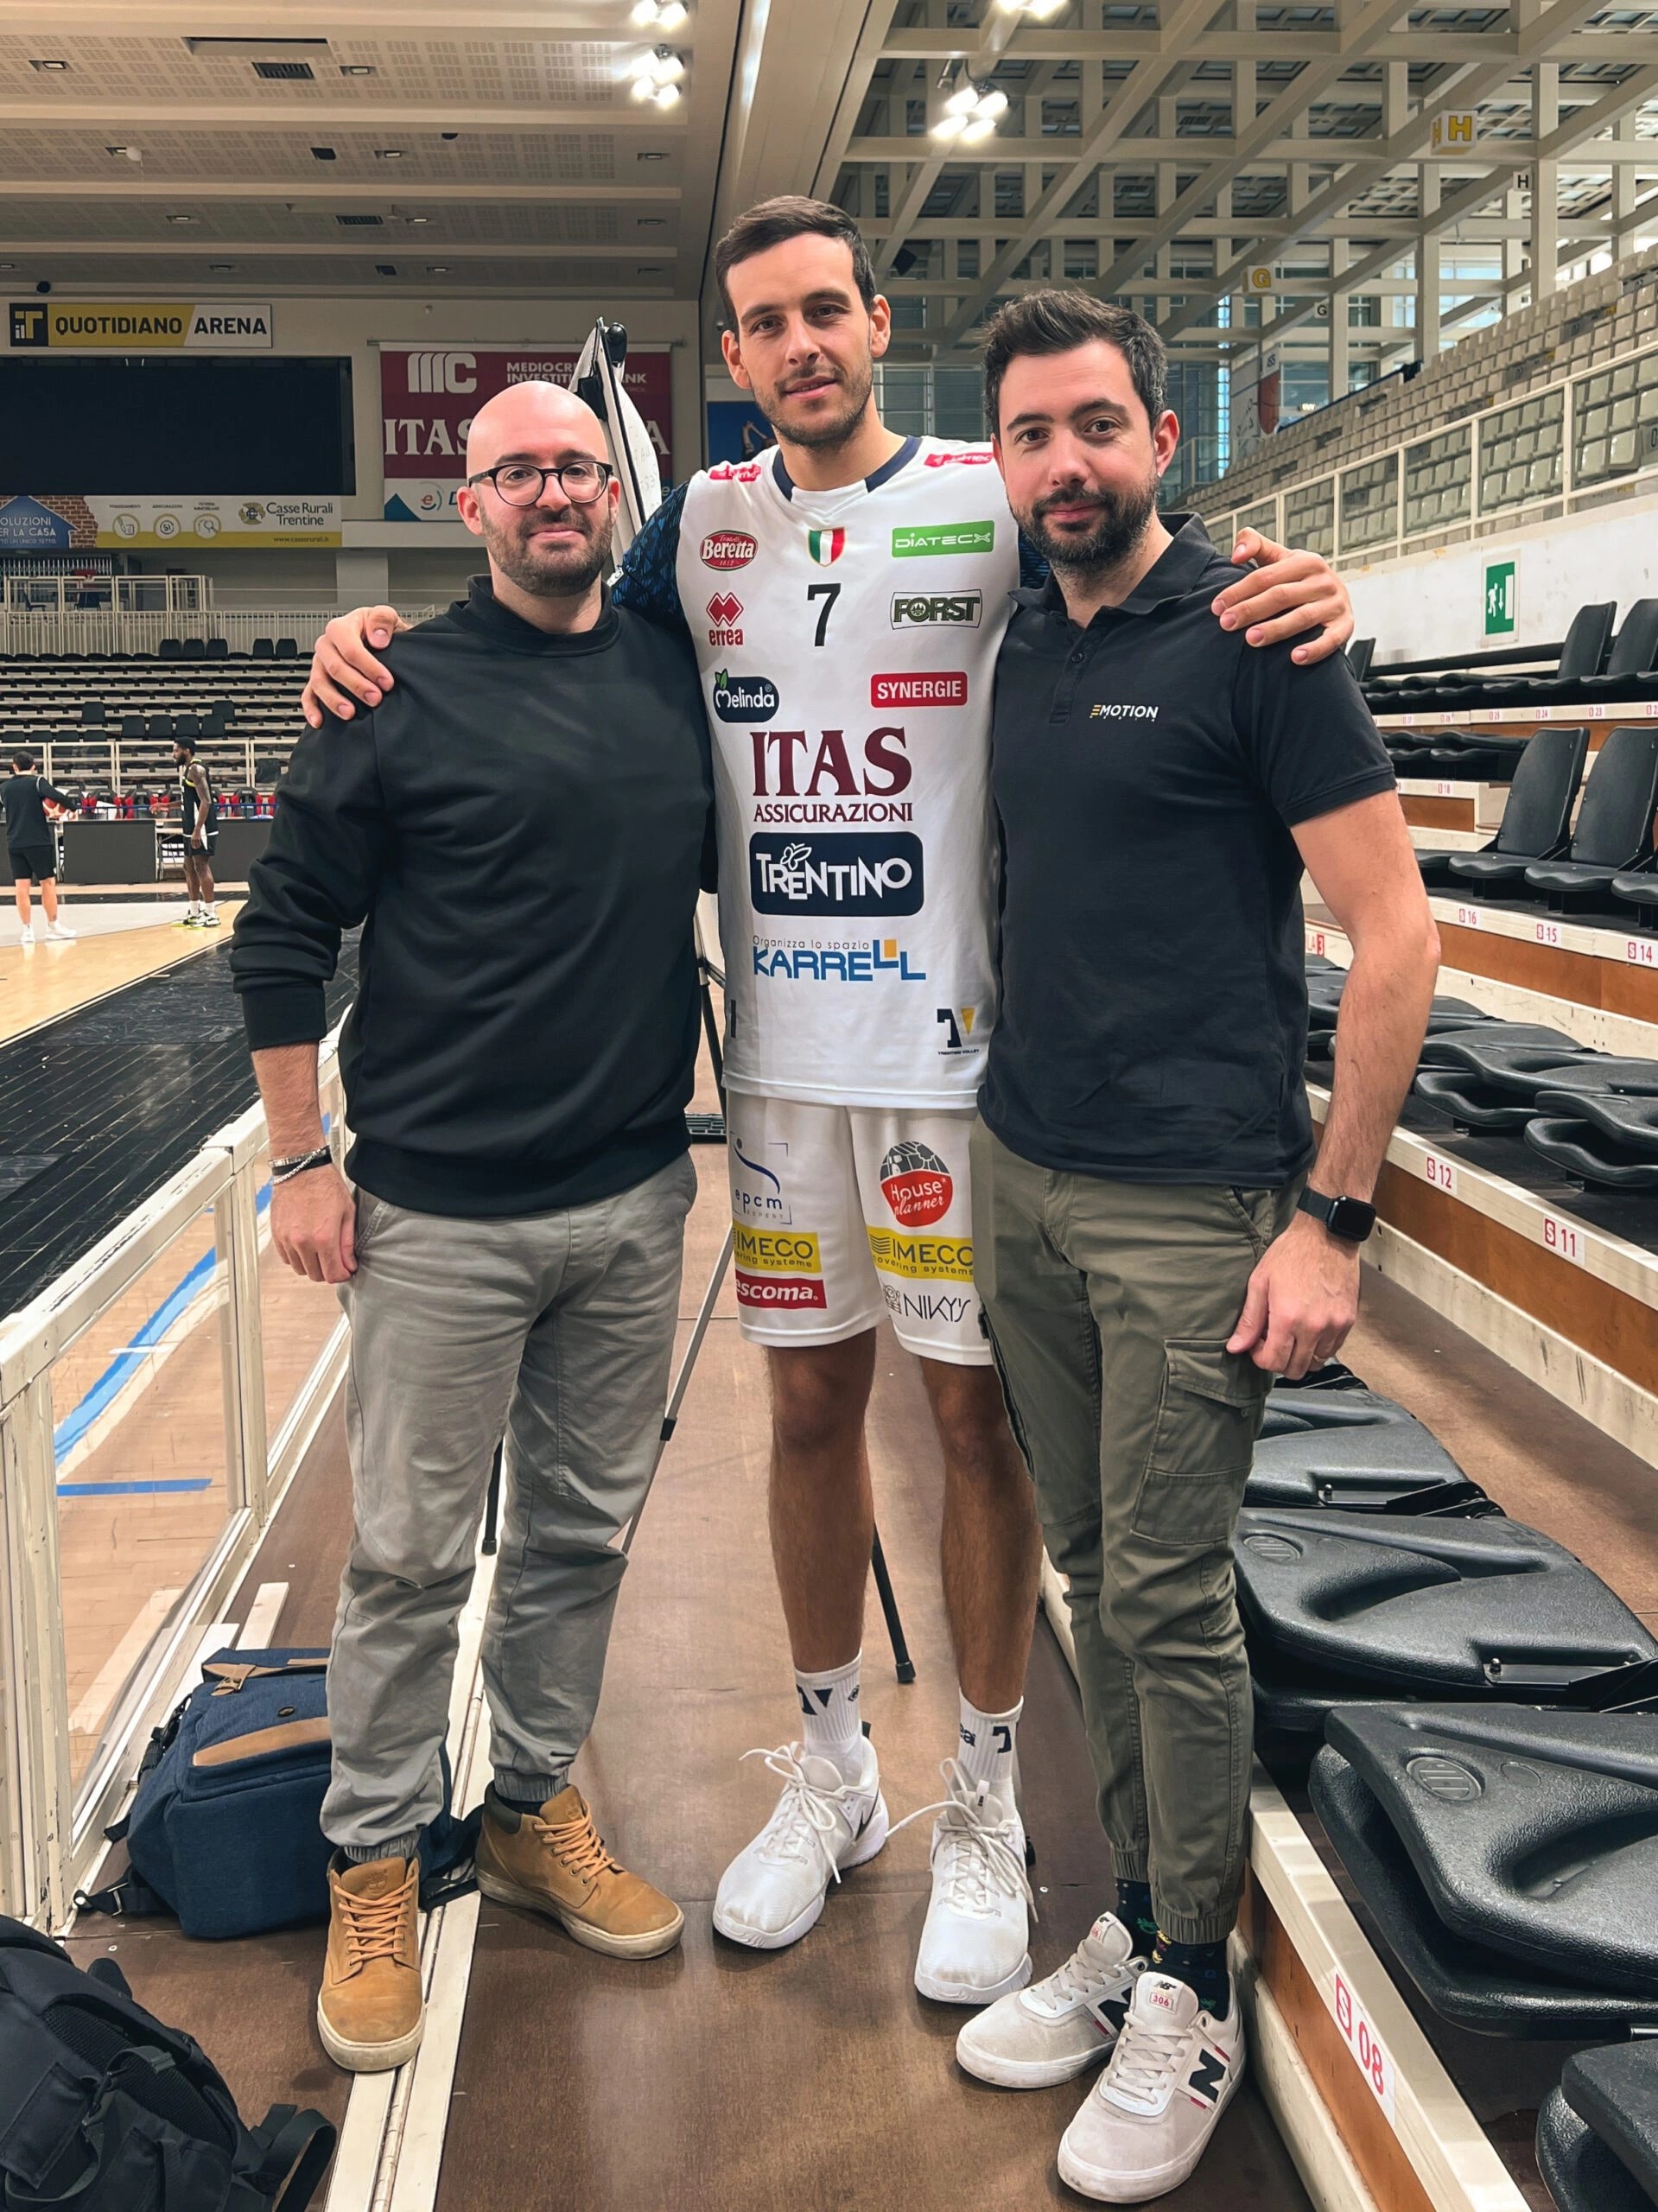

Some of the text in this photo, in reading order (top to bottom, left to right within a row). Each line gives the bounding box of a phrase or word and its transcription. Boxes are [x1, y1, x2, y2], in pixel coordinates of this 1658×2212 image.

[1448, 115, 1472, 142] H
[1517, 175, 1528, 188] H
[1252, 268, 1271, 289] G
[1317, 304, 1328, 315] G
[55, 316, 267, 335] QUOTIDIANO ARENA
[266, 502, 333, 514] Casse Rurali
[276, 514, 324, 525] Trentine
[29, 528, 56, 537] CASA
[702, 538, 754, 560] Beretta
[807, 582, 842, 646] 7
[893, 596, 981, 623] FORST
[708, 629, 744, 646] errea
[715, 686, 775, 709] Melinda
[877, 681, 962, 700] SYNERGIE
[1090, 704, 1159, 719] EMOTION
[749, 727, 912, 797] ITAS
[753, 802, 913, 823] ASSICURAZIONI
[755, 853, 912, 901] TRENTINO
[1468, 911, 1477, 925] 16
[753, 935, 870, 951] Organizza lo spazio
[1547, 926, 1557, 943] 15
[753, 939, 926, 982] KARRELL
[1641, 945, 1652, 963] 14
[1439, 1165, 1452, 1189] 12
[891, 1181, 943, 1202] House
[737, 1230, 813, 1259] IMECO
[1561, 1229, 1576, 1257] 11
[764, 1258, 812, 1268] systems
[903, 1293, 971, 1322] NIKY'S
[1153, 1994, 1170, 2006] 306
[1359, 2021, 1384, 2095] 08
